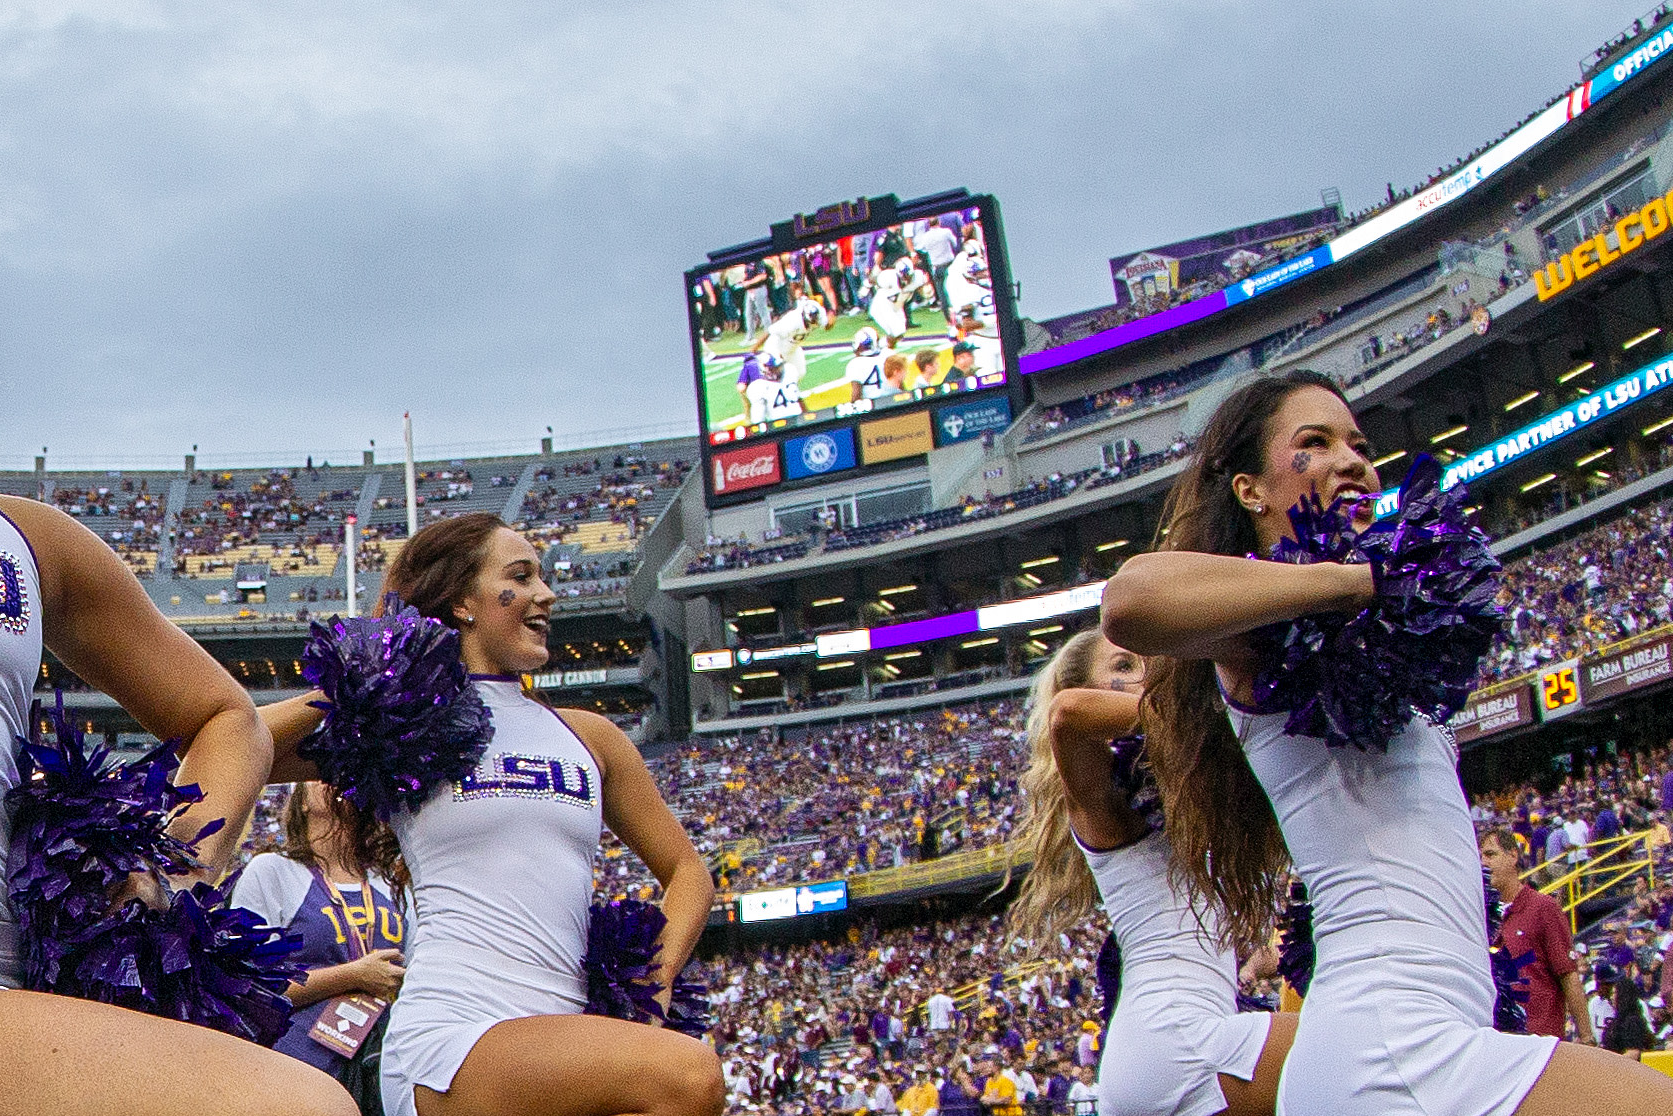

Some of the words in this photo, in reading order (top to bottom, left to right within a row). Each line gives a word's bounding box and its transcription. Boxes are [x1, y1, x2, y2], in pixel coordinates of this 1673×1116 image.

[1613, 29, 1673, 82] OFFICIA
[793, 196, 870, 239] LSU
[1533, 188, 1673, 302] WELCO
[1442, 449, 1495, 490] RVICE
[1496, 411, 1576, 462] PARTNER
[1577, 396, 1602, 422] OF
[1605, 376, 1640, 409] LSU
[1589, 660, 1622, 682] FARM
[1623, 643, 1668, 672] BUREAU
[1450, 707, 1476, 727] ARM
[1477, 693, 1518, 718] BUREAU
[1543, 668, 1577, 710] 25
[453, 752, 598, 810] LSU
[316, 1020, 359, 1048] WORKING
